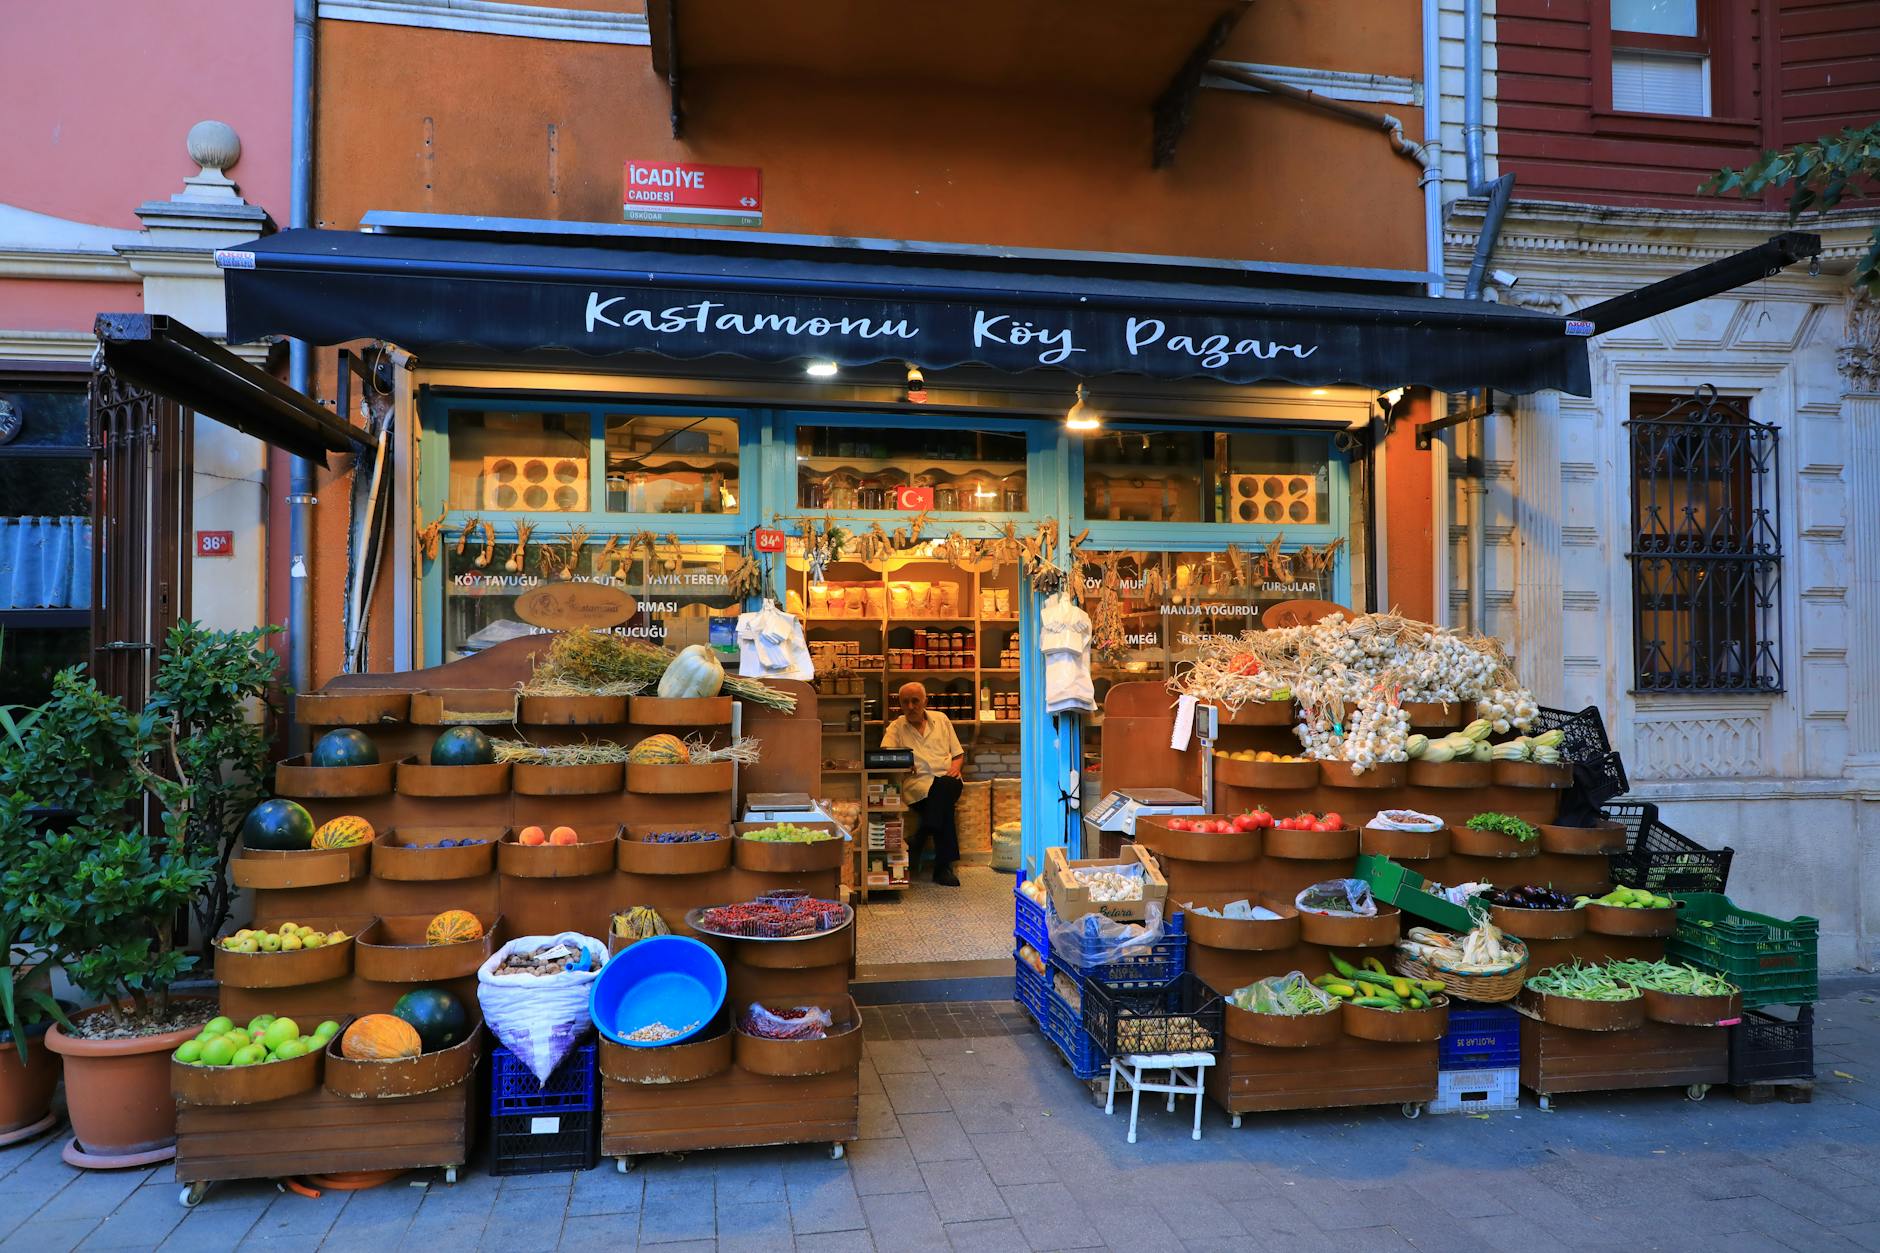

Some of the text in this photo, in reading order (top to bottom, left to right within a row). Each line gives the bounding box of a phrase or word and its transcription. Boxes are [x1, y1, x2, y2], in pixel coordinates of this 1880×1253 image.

[629, 164, 705, 189] İCADİYE
[628, 190, 674, 202] CADDESİ
[585, 291, 919, 338] Kastamonu
[974, 310, 1086, 364] Köy
[202, 536, 227, 550] 36A
[760, 534, 780, 547] 34A
[455, 573, 538, 586] KÖY TAVUĞU
[647, 574, 729, 585] YAYIK TEREYA
[637, 602, 678, 612] RMASI
[1160, 603, 1259, 616] MANDA YOĞURDU
